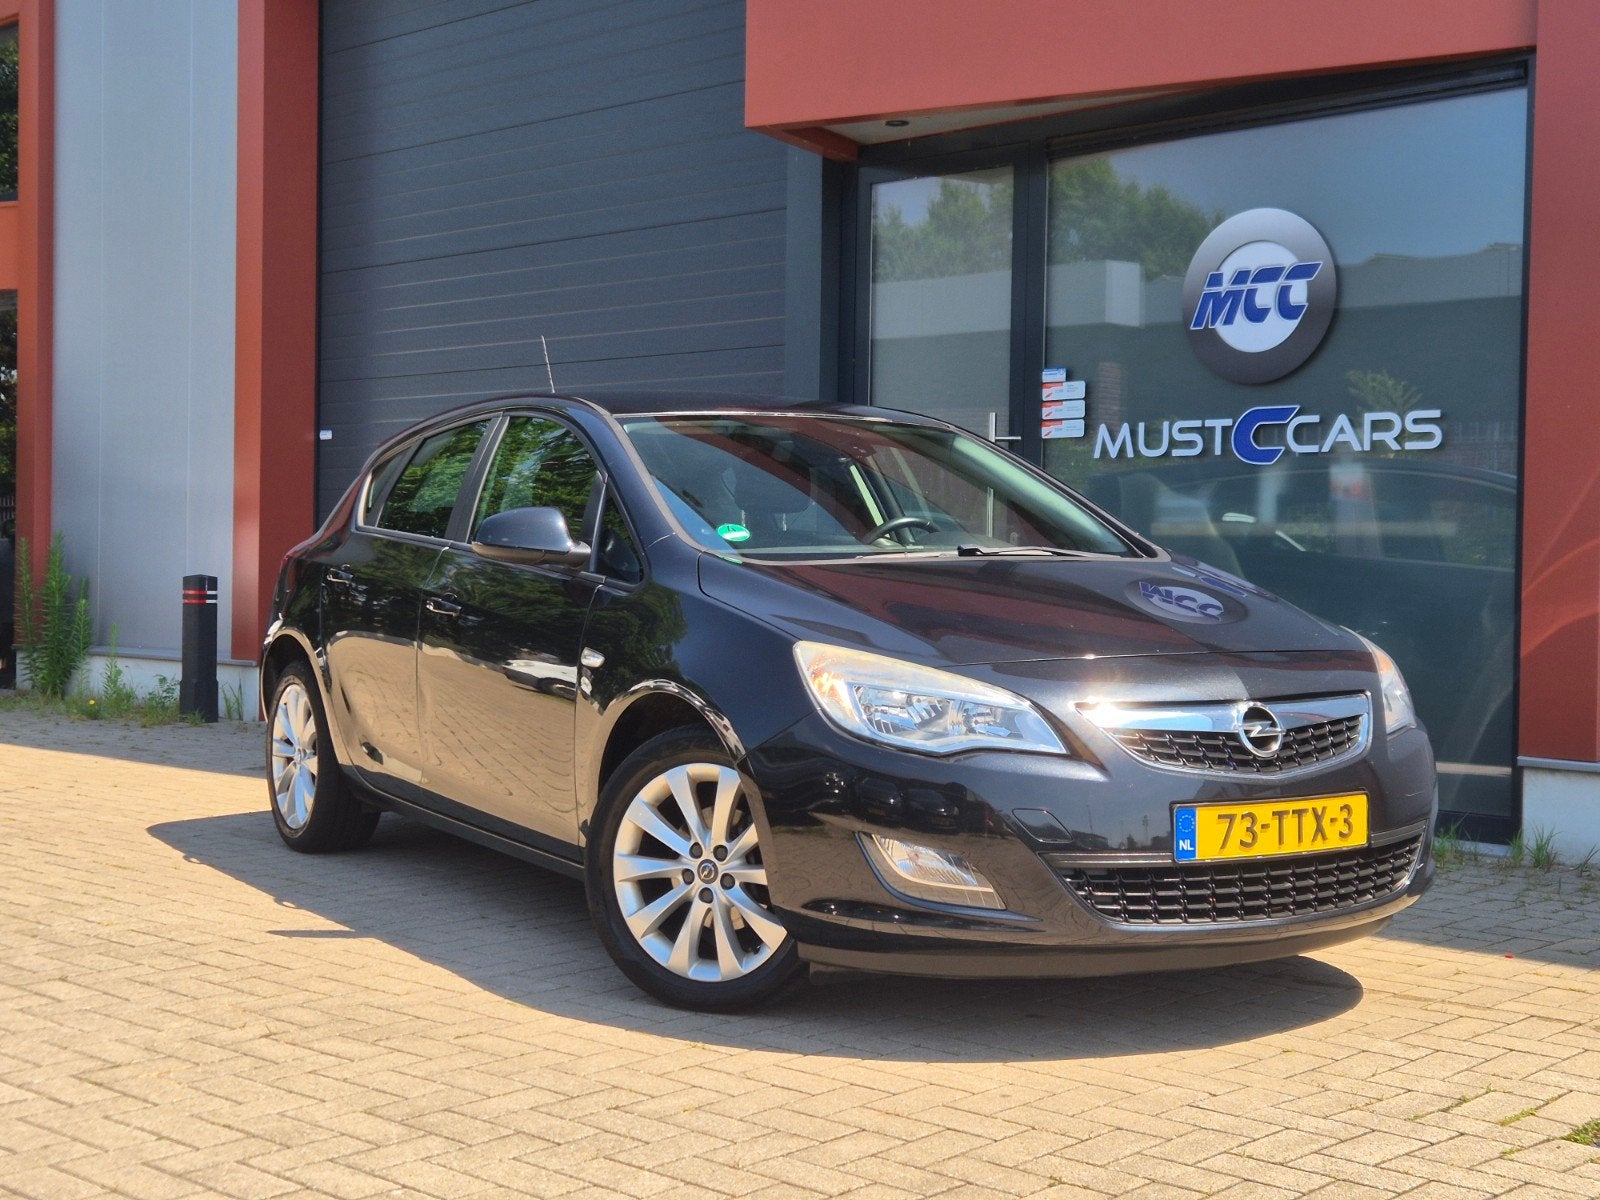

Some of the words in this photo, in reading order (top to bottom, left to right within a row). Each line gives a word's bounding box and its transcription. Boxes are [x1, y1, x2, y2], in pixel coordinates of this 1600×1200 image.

[1190, 262, 1322, 330] MCC
[1179, 839, 1194, 851] NL
[1217, 804, 1354, 851] 73-TTX-3
